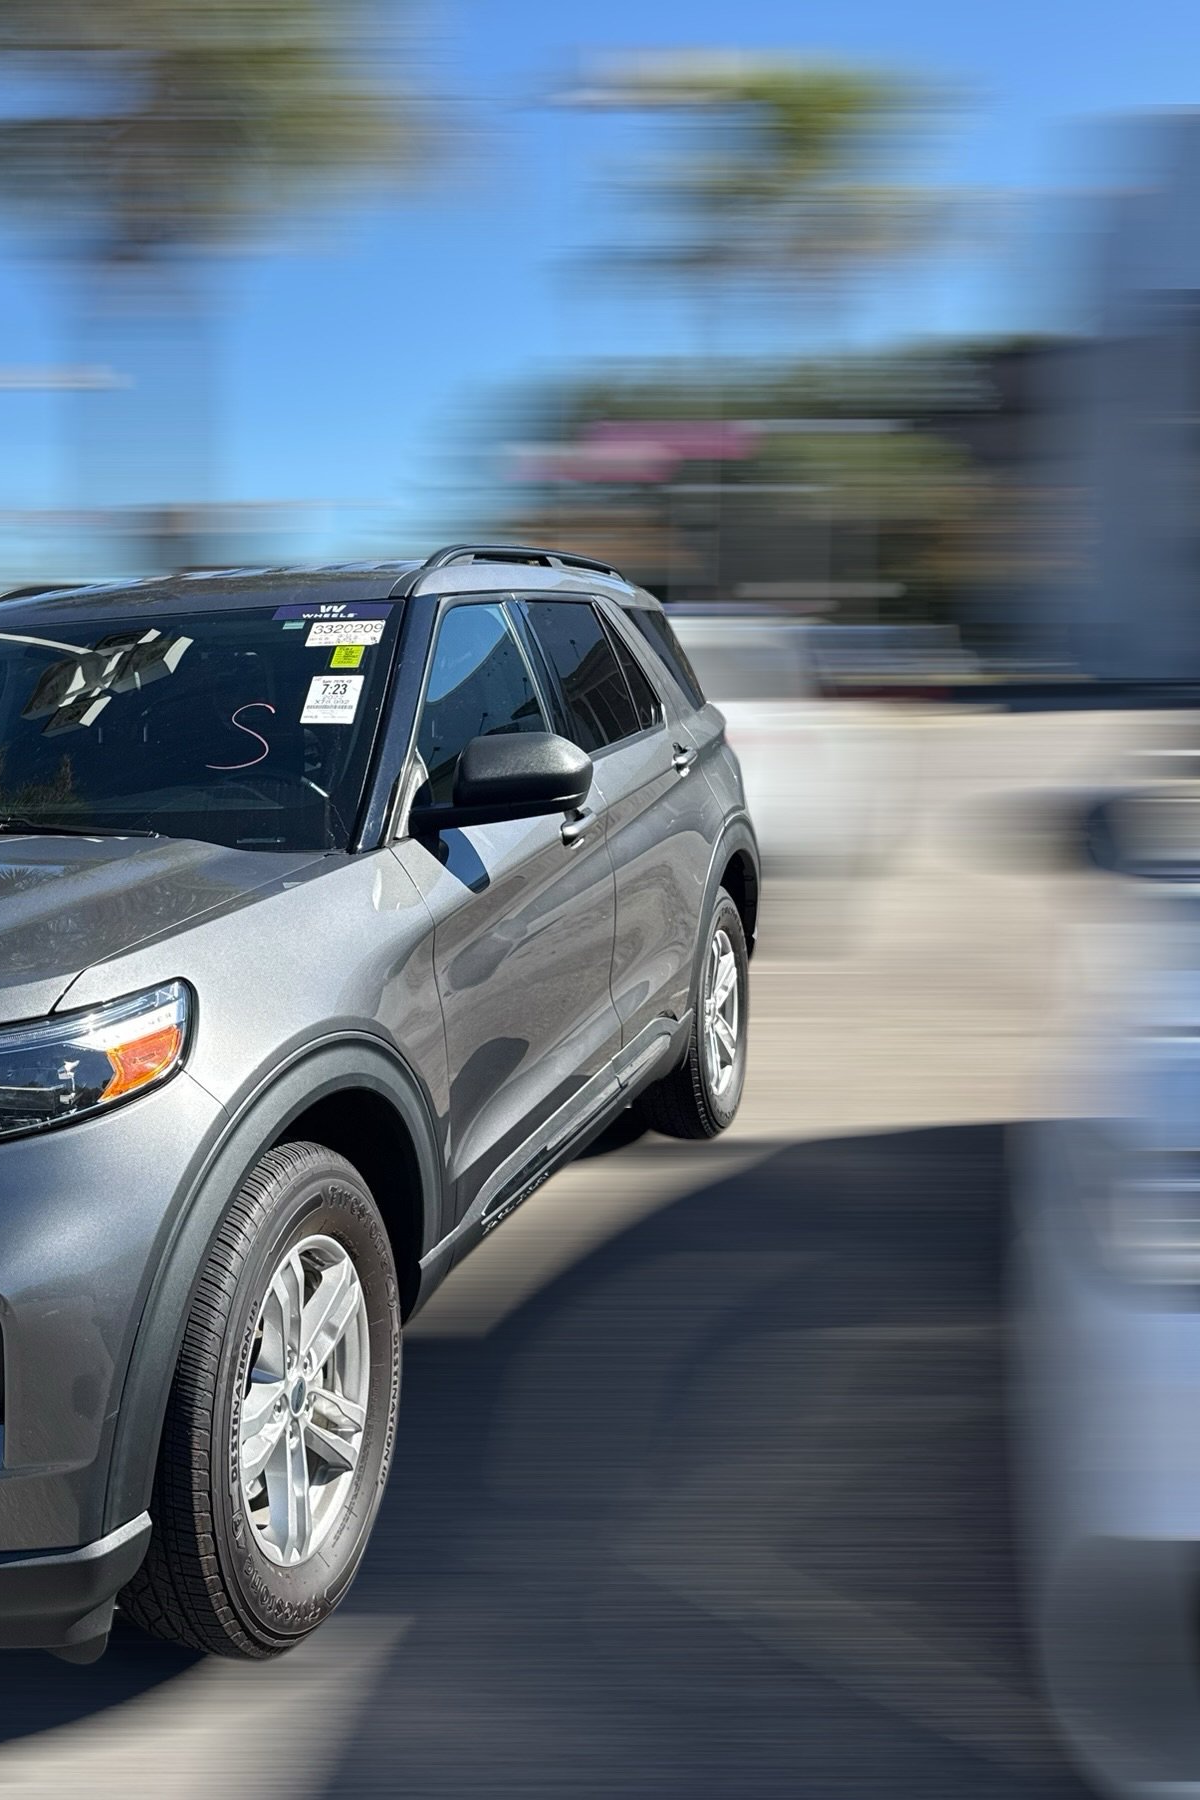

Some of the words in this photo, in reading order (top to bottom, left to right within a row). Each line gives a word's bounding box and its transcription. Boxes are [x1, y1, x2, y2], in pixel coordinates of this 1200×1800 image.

[313, 624, 383, 635] 3320209
[321, 684, 348, 695] 7:23
[204, 703, 276, 769] S
[231, 1326, 252, 1483] DESTINATION
[384, 1332, 399, 1461] DESTINATION
